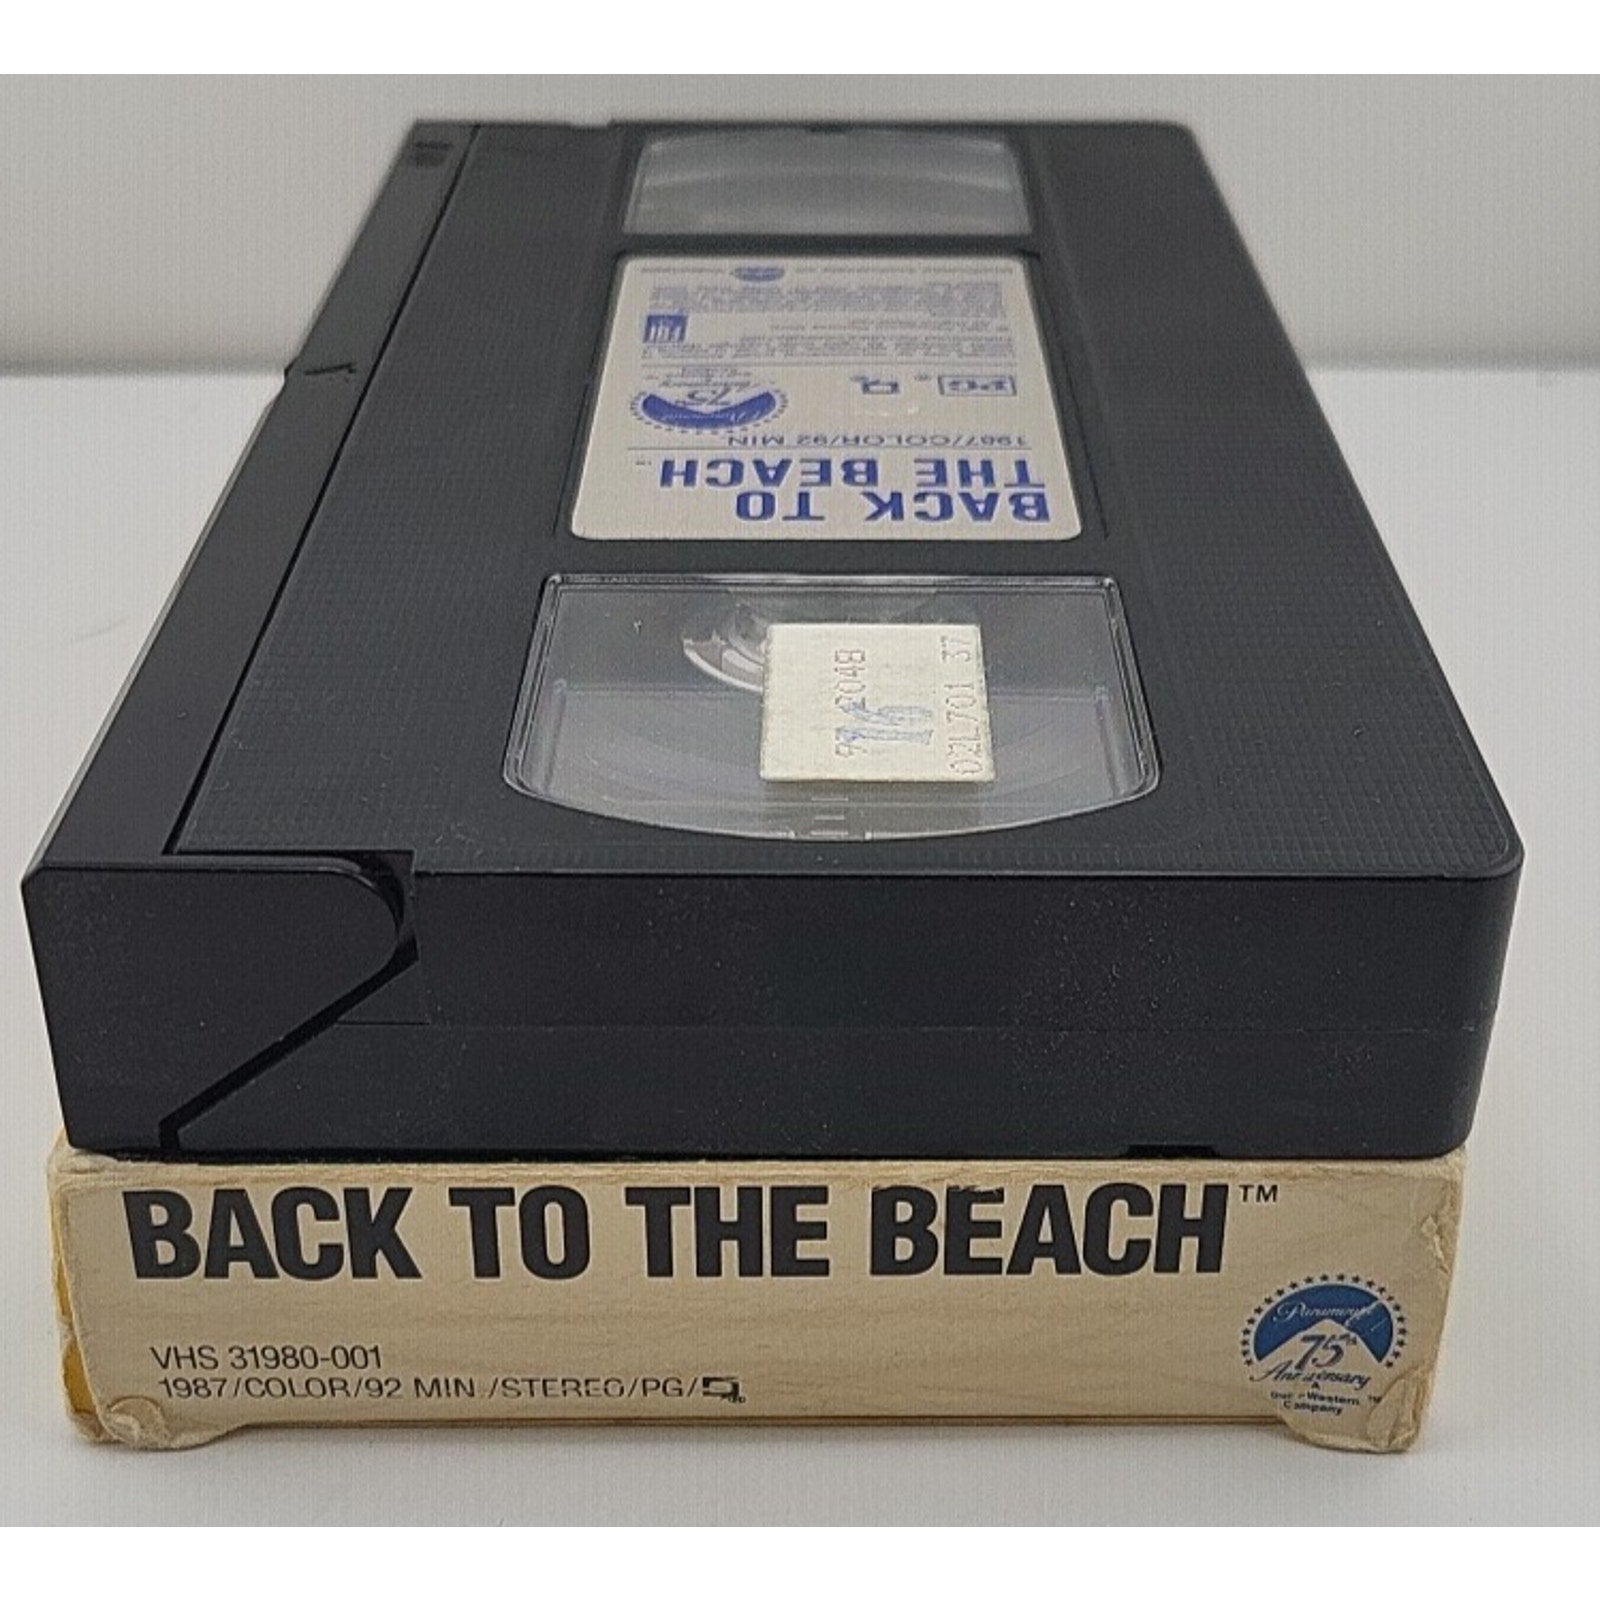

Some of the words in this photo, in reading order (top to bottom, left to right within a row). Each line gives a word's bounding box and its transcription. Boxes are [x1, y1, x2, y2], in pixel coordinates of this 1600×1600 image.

[659, 457, 879, 488] BEACH
[914, 457, 1045, 488] THE
[736, 491, 826, 523] TO
[862, 491, 1052, 523] BACK
[122, 1187, 421, 1279] BACK
[448, 1185, 591, 1279] TO
[625, 1185, 830, 1277] THE
[869, 1182, 1229, 1275] BEACH
[1239, 1184, 1279, 1204] TM
[151, 1346, 219, 1370] VHS
[228, 1345, 382, 1370] 31980-001
[158, 1376, 402, 1399] 1987/COLOR/92
